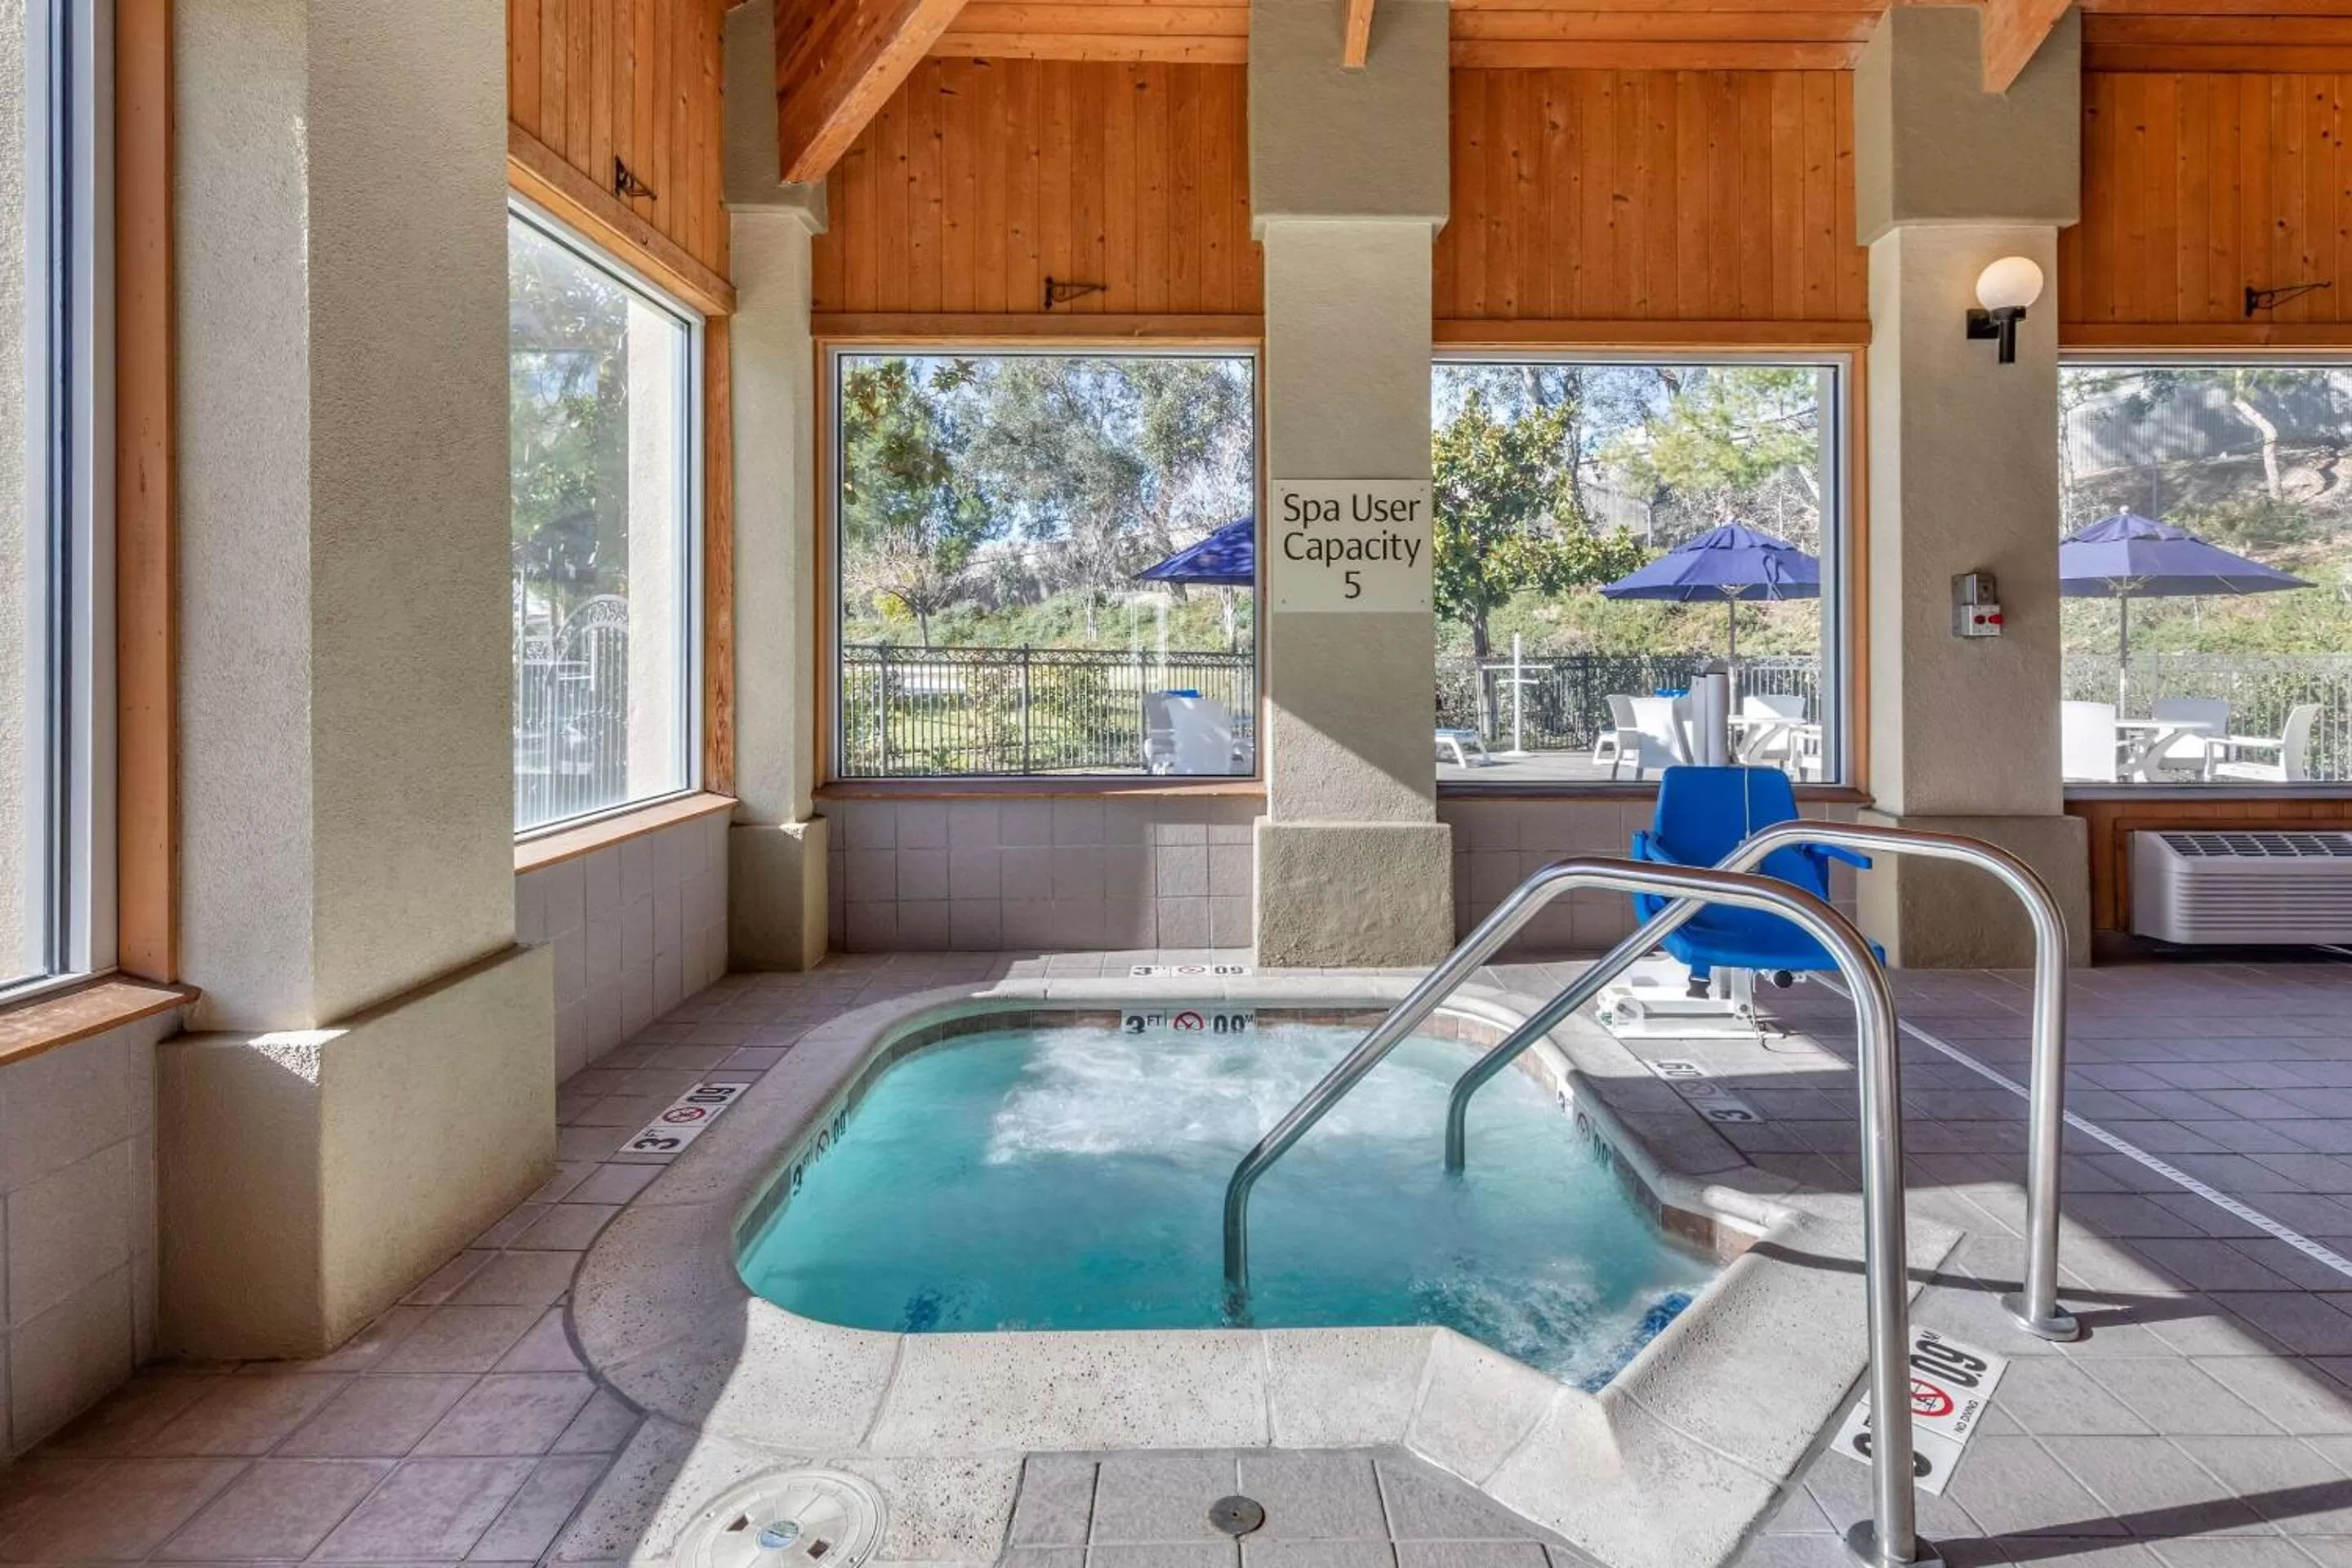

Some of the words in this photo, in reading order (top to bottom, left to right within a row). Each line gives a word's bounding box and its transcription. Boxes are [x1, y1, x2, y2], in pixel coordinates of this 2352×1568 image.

[1284, 493, 1339, 528] Spa
[1352, 493, 1421, 522] User
[1284, 529, 1421, 567] Capacity
[1344, 571, 1361, 599] 5
